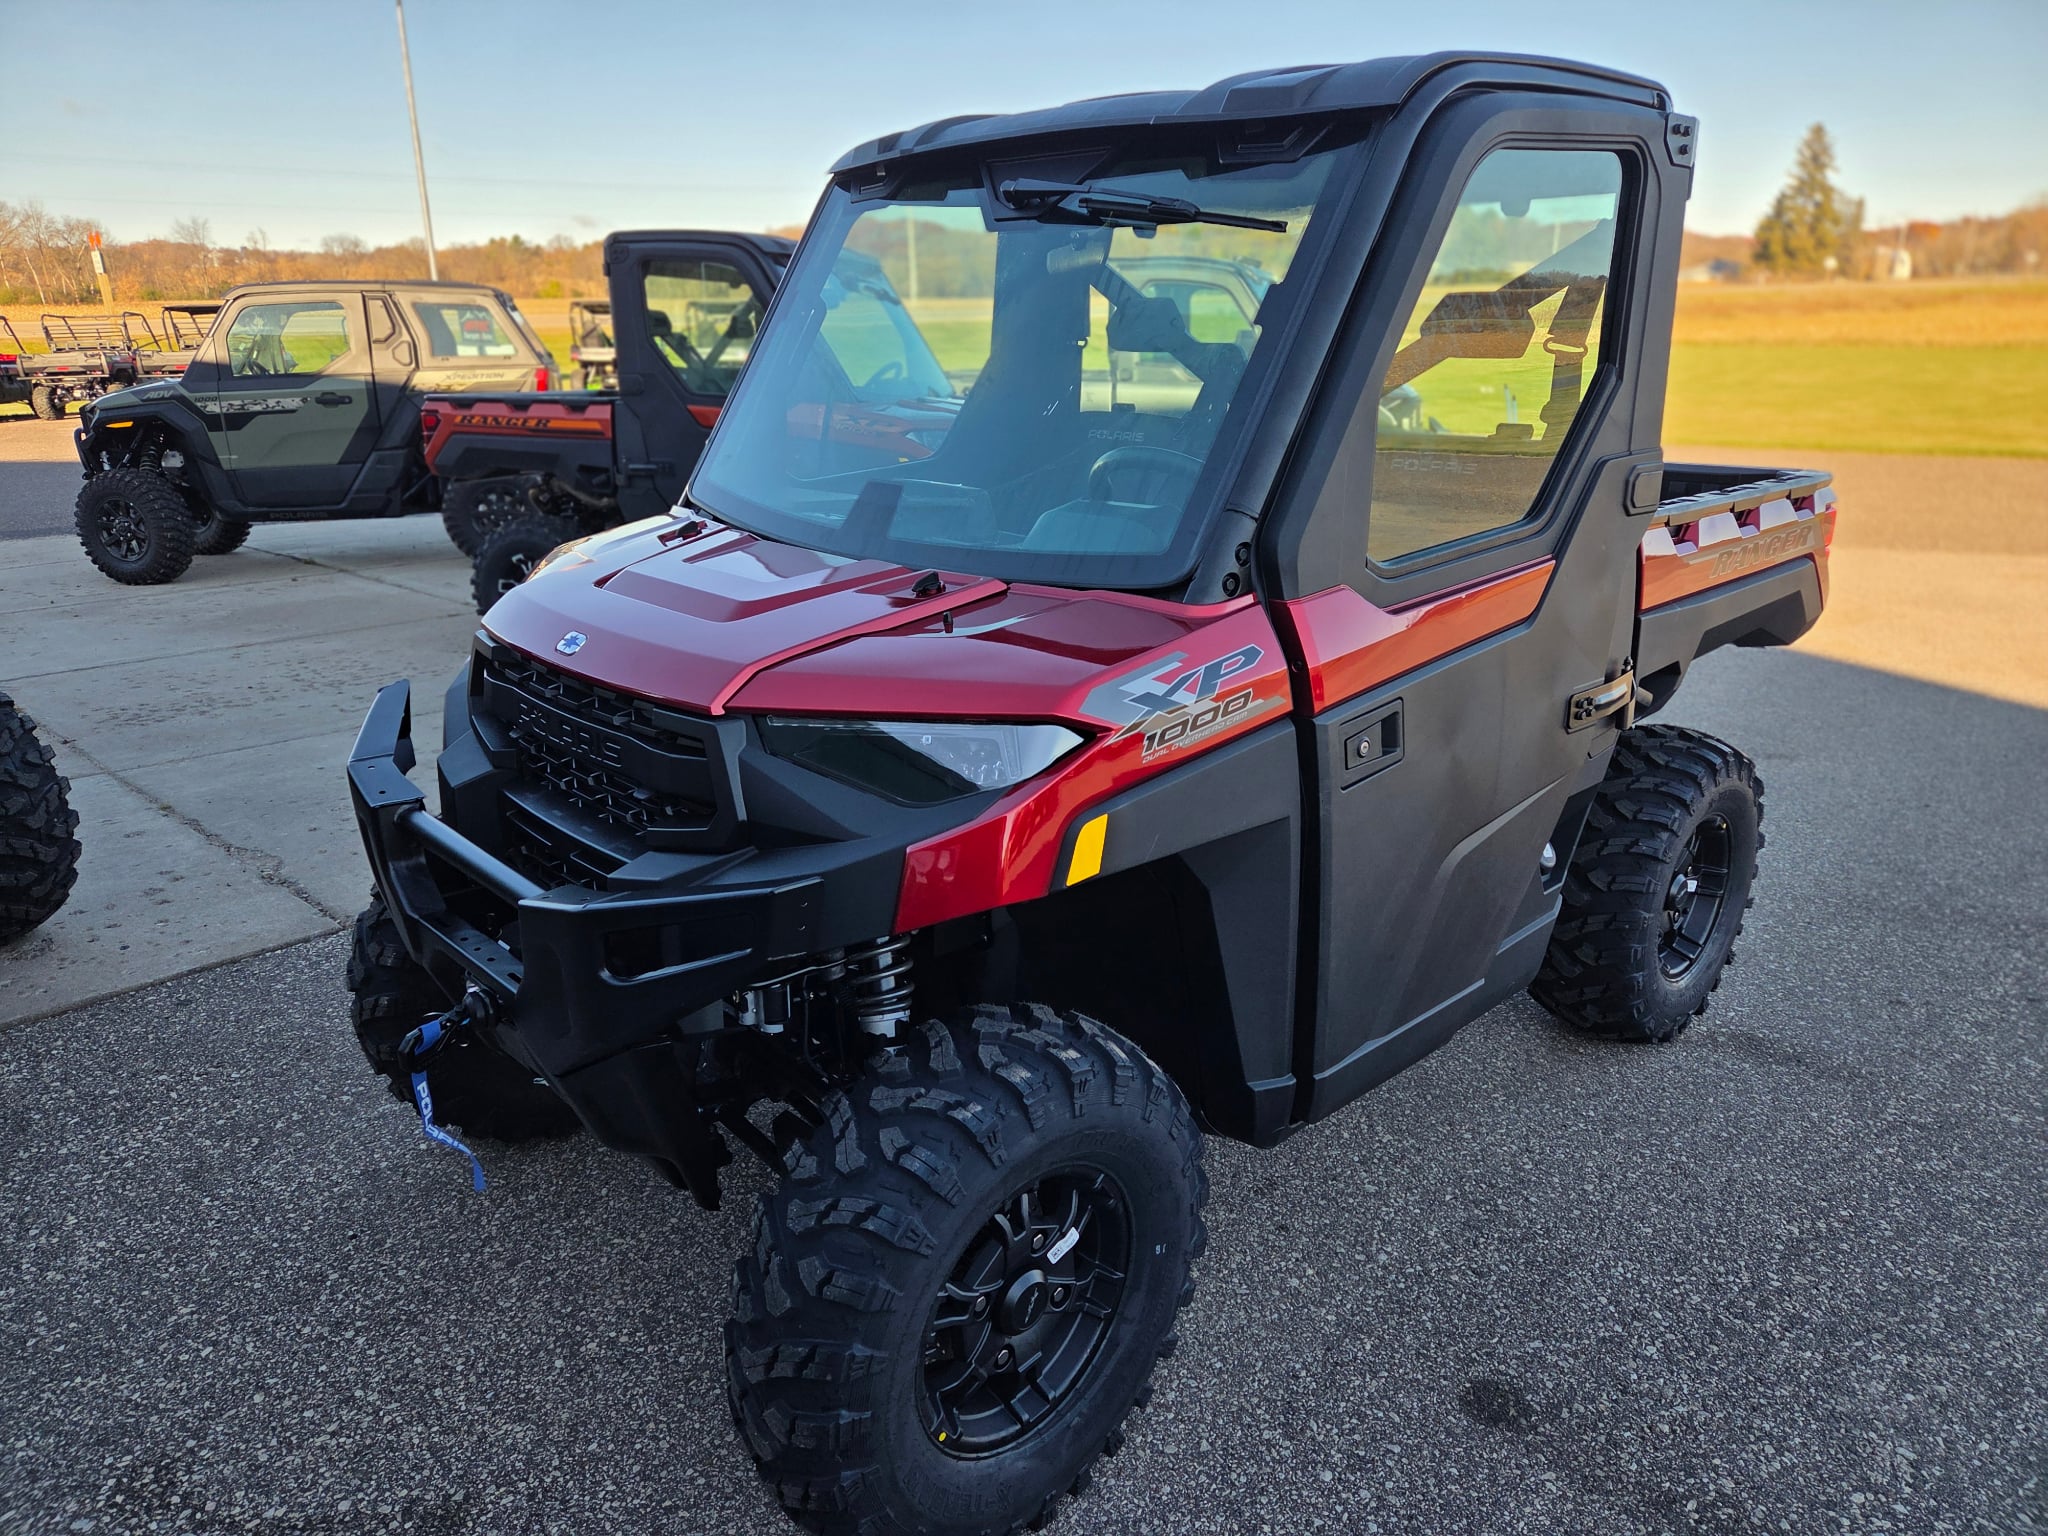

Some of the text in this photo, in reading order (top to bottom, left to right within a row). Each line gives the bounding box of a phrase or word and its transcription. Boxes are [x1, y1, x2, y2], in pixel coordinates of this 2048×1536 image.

[443, 370, 504, 381] XPEDITION
[143, 390, 174, 400] ADV
[458, 415, 551, 428] RANGER
[1088, 429, 1145, 442] POLARIS
[1391, 458, 1478, 474] POLARIS
[1709, 524, 1815, 579] RANGER
[1103, 643, 1264, 747] XP
[517, 703, 622, 768] POLARIS
[1142, 688, 1253, 757] 1000
[1142, 711, 1248, 764] DUAL OVERHEAD CAM
